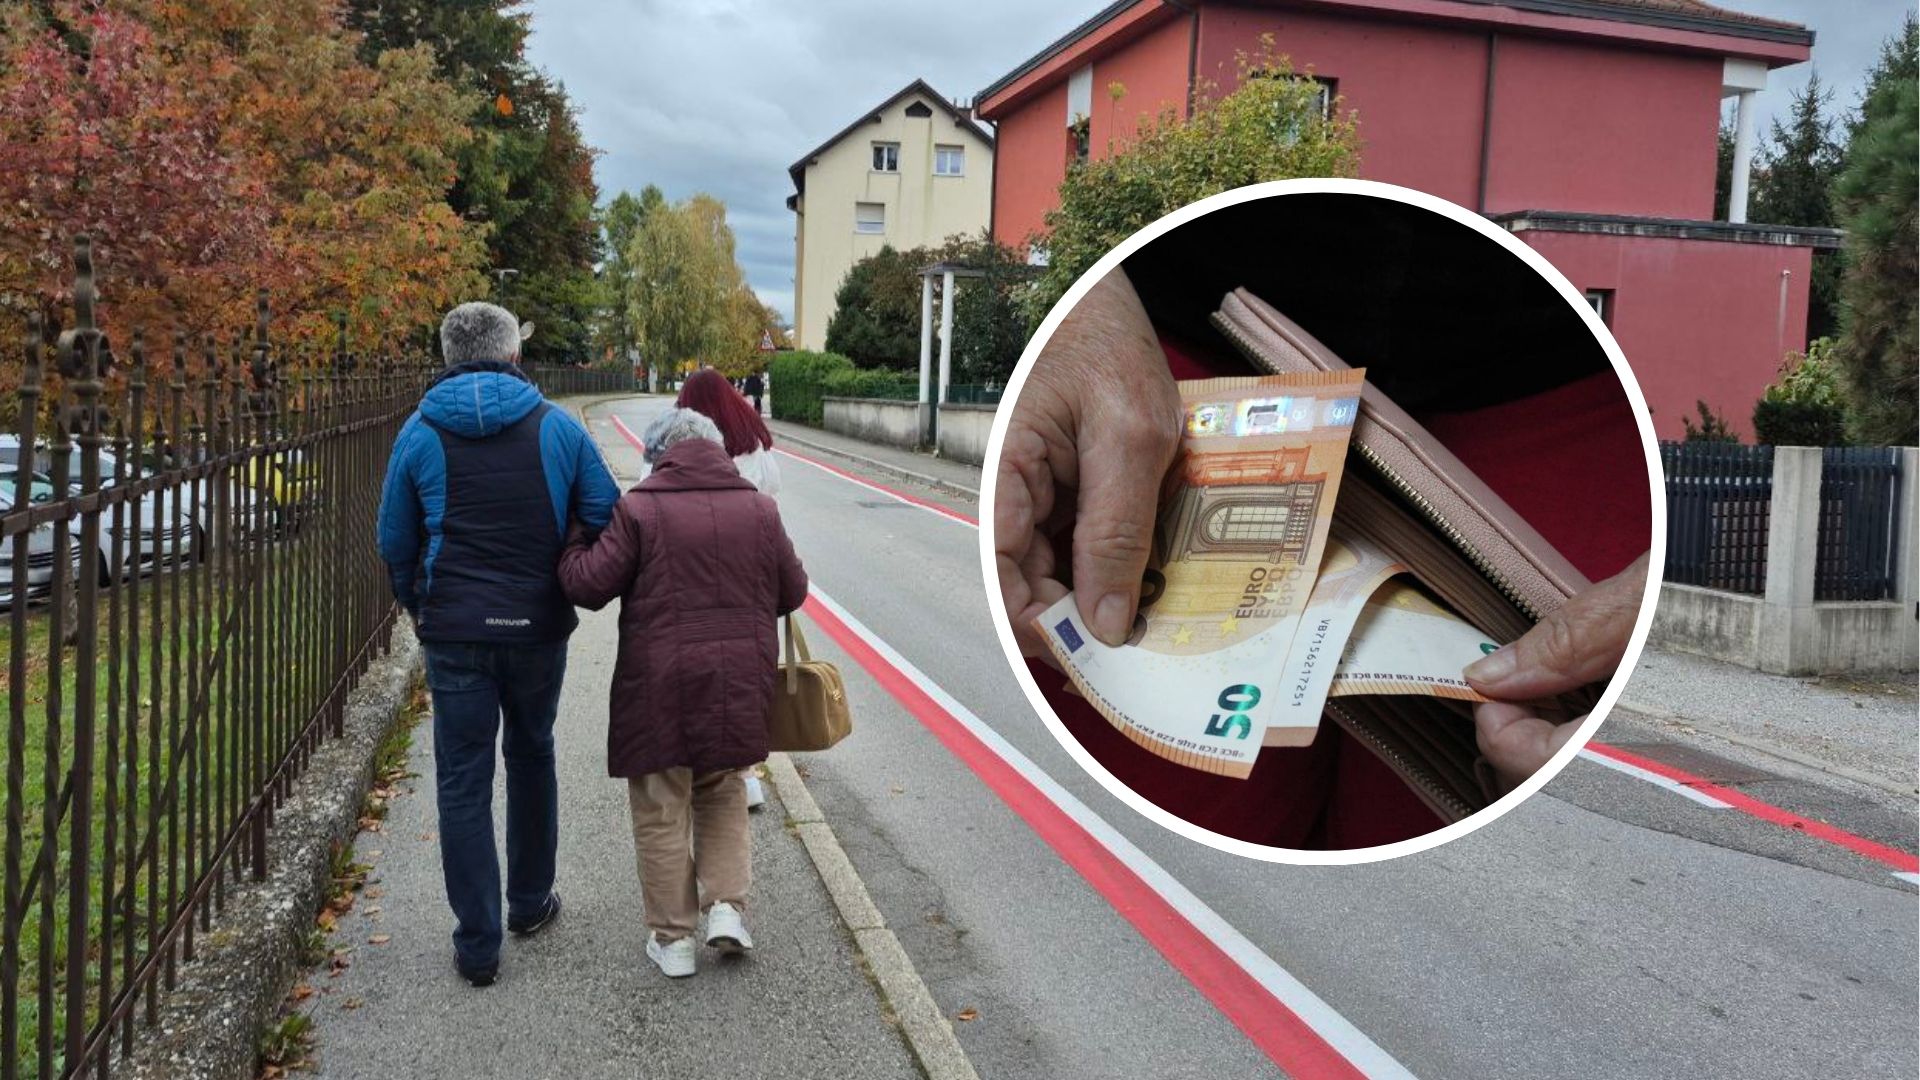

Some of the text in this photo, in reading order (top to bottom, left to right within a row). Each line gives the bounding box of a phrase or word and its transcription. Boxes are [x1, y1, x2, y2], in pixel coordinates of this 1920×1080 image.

[1235, 566, 1267, 619] EURO
[1291, 618, 1332, 708] VB7156217251
[1203, 683, 1262, 740] 50
